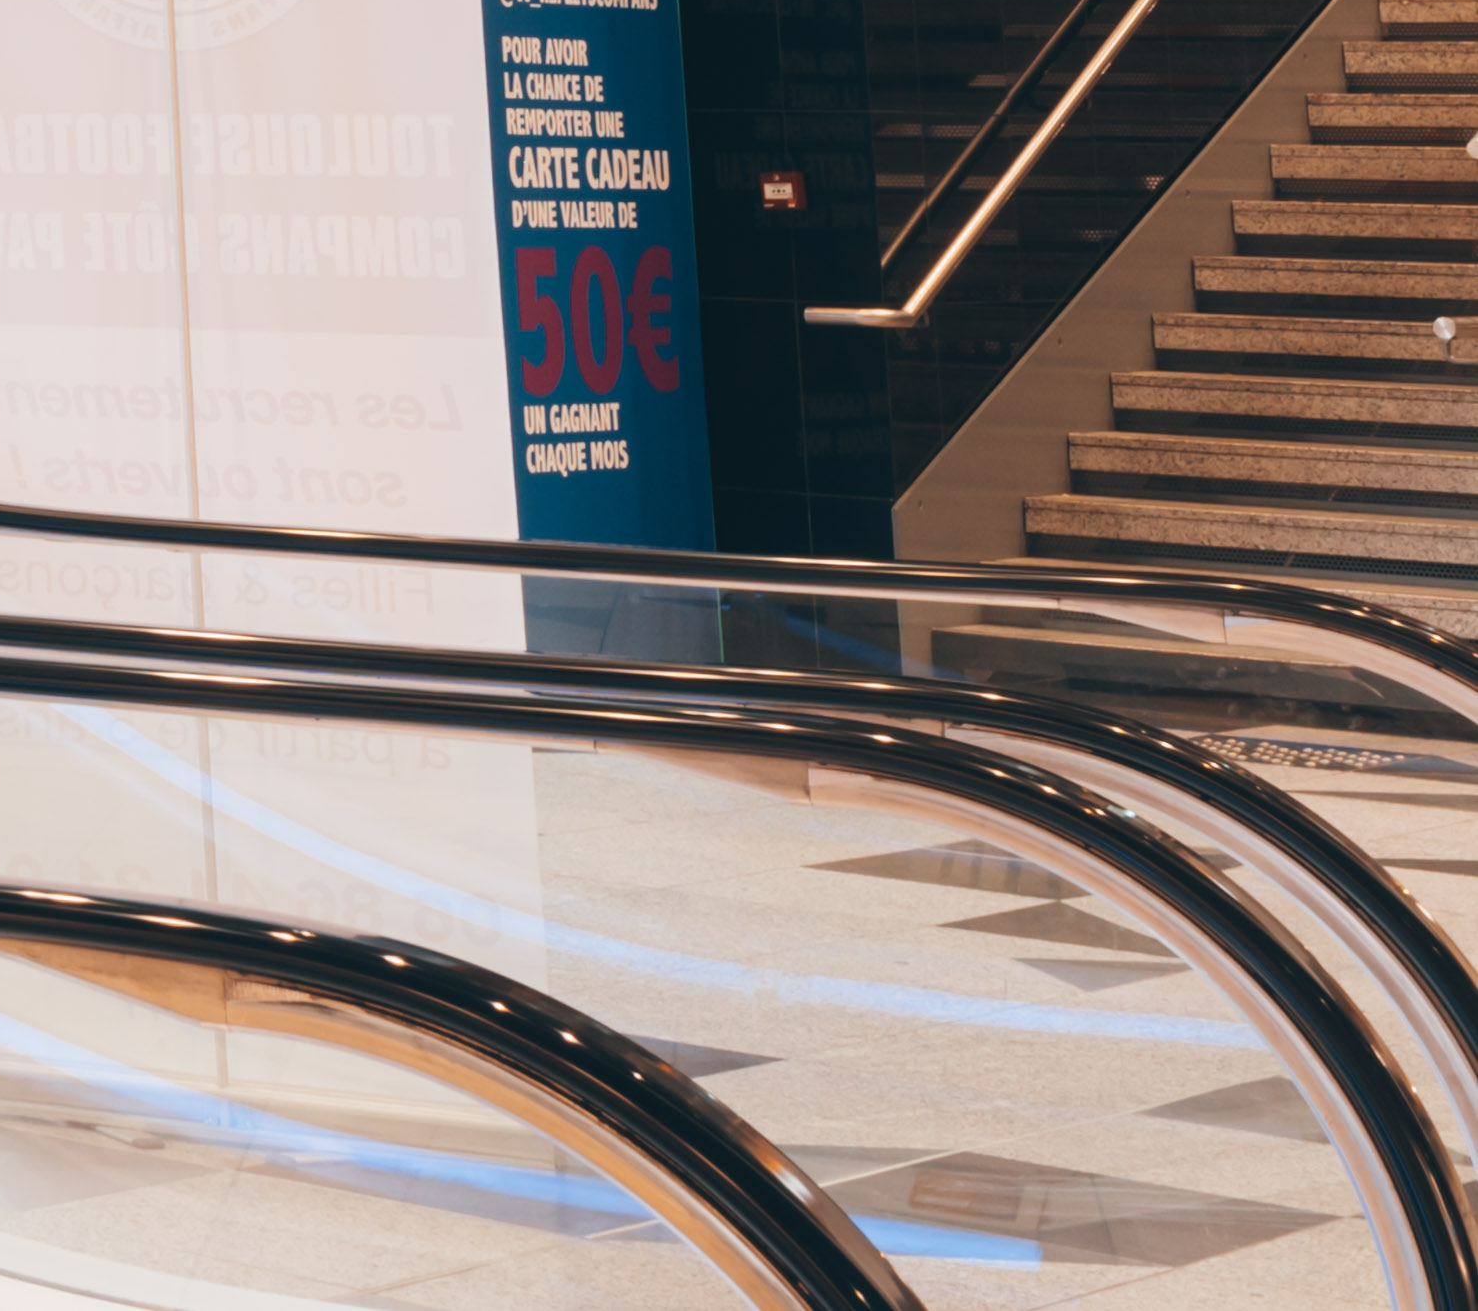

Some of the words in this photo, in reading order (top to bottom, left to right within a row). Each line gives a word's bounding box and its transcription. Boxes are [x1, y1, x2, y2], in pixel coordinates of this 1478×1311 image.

[501, 36, 541, 65] POUR
[546, 38, 587, 66] AVOIR
[504, 72, 523, 99] LA
[527, 73, 581, 101] CHANCE
[585, 75, 604, 102] DE
[506, 108, 592, 137] REMPORTER
[596, 111, 624, 138] UNE
[509, 146, 580, 189] CARTE
[586, 149, 670, 191] CADEAU
[512, 201, 558, 228] D'UNE
[561, 201, 615, 229] VALEUR
[618, 202, 638, 228] DE
[516, 245, 680, 398] 50€
[524, 405, 547, 434] UN
[550, 402, 619, 432] GAGNANT
[526, 442, 587, 477] CHAQUE
[591, 440, 629, 469] MOIS
